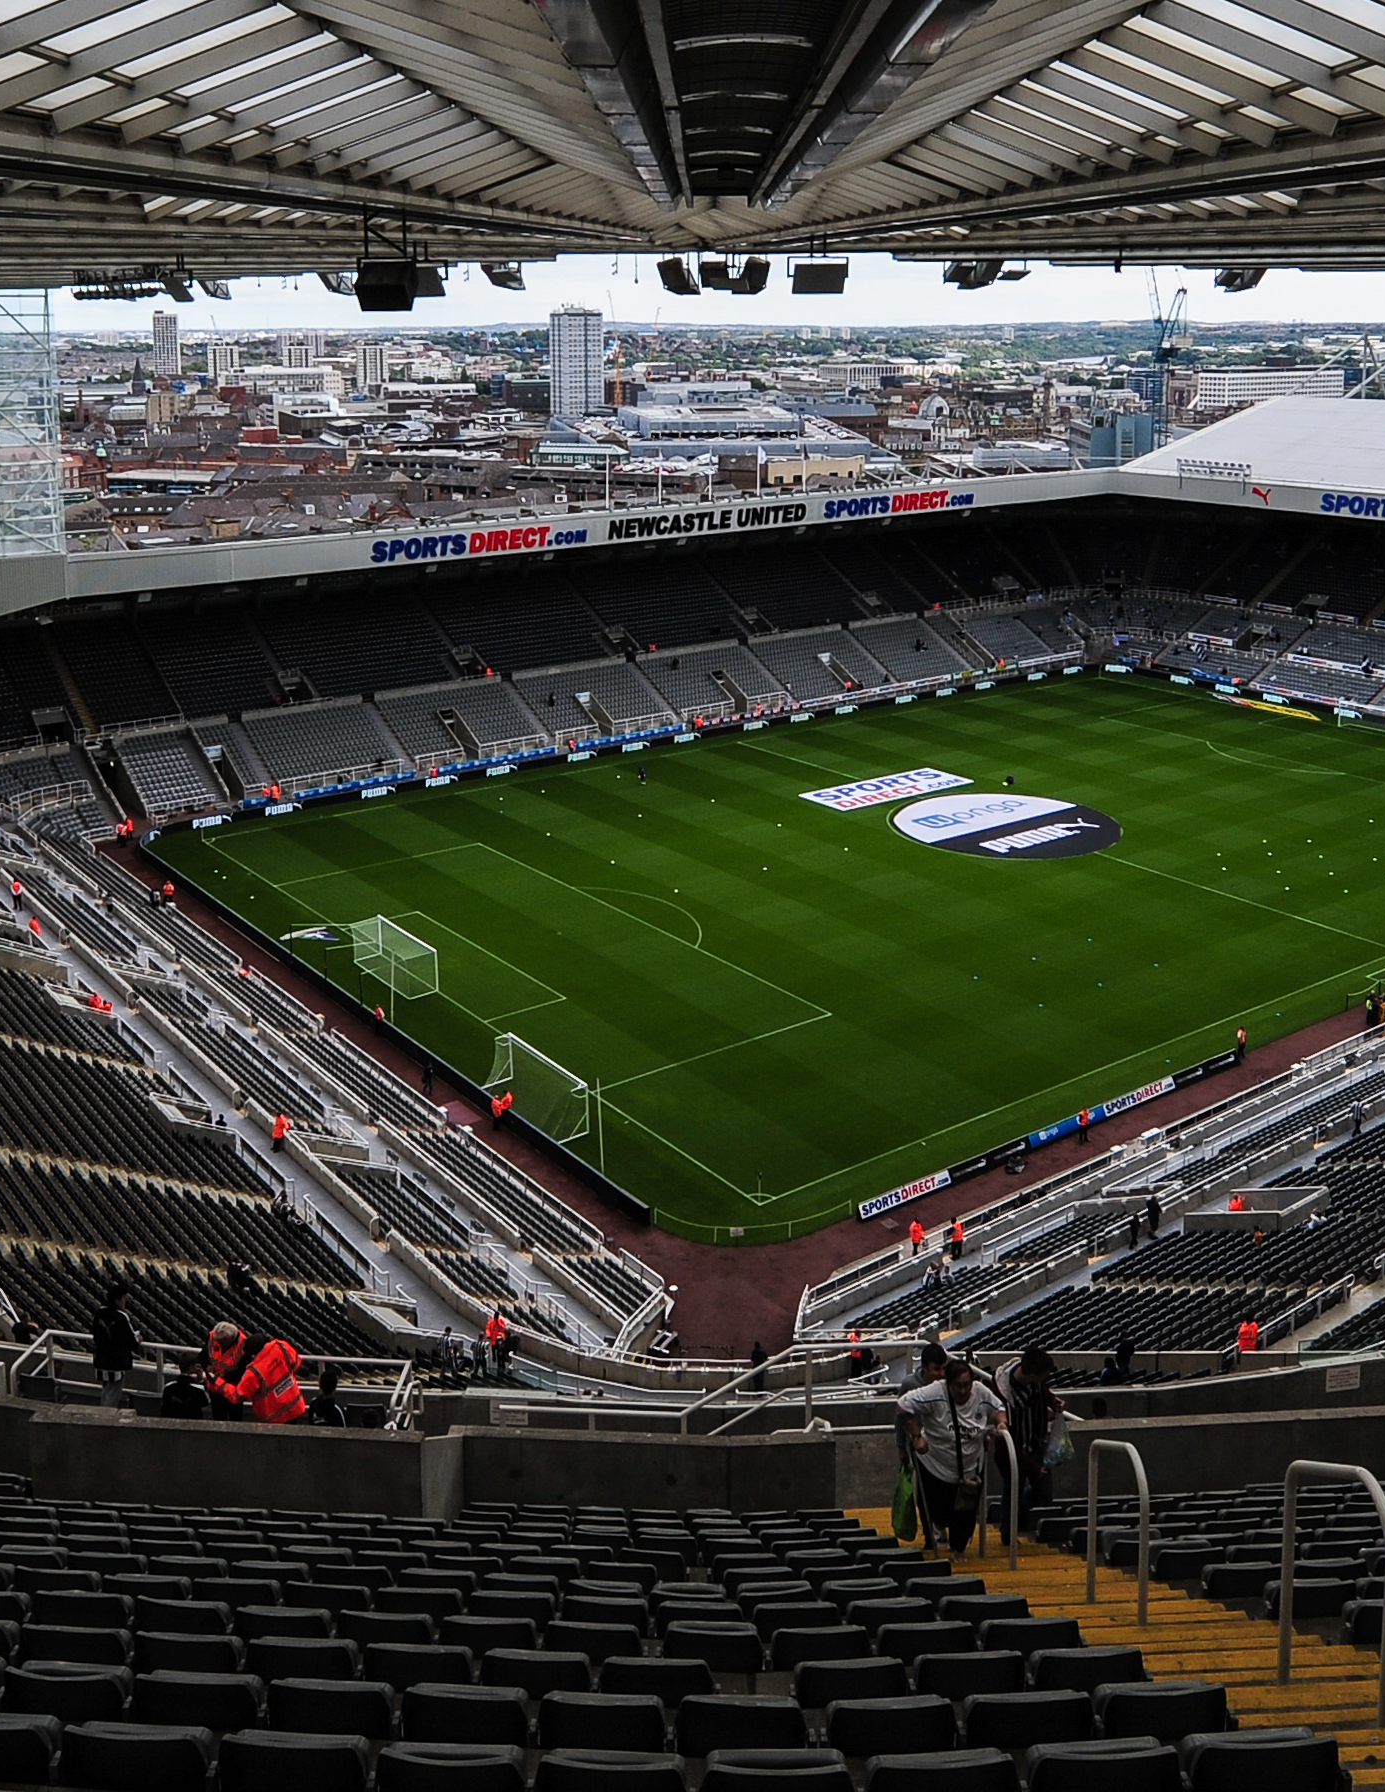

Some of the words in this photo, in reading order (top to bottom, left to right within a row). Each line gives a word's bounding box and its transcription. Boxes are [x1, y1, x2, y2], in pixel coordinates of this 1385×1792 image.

[608, 510, 732, 540] NEWCASTLE
[737, 503, 807, 528] UNITED
[361, 786, 388, 800] PUMA
[812, 770, 942, 801] SPORTS
[264, 802, 294, 817] PUMA
[911, 799, 1027, 829] wonga
[979, 824, 1072, 853] PUMA
